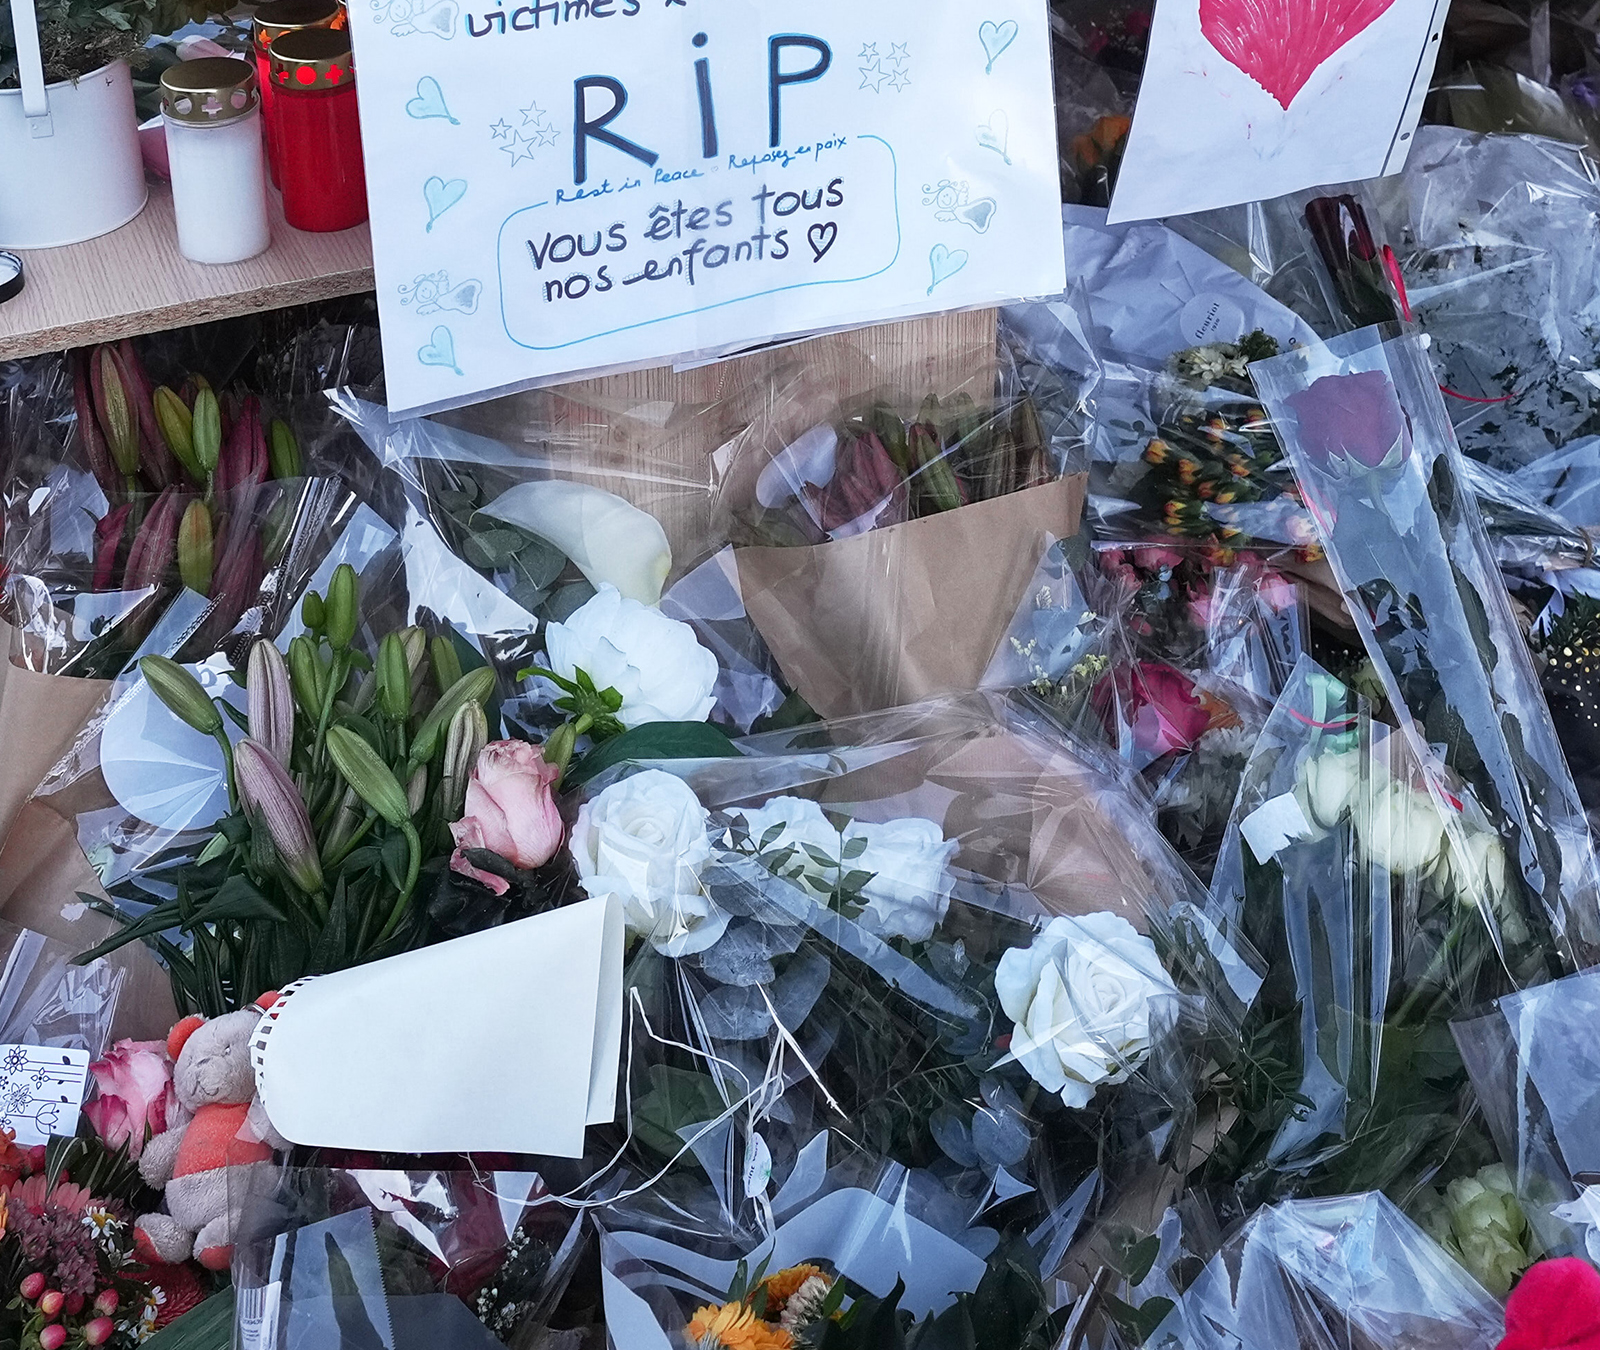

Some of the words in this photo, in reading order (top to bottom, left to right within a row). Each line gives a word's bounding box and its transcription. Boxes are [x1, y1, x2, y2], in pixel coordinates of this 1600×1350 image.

[556, 178, 614, 205] Rest
[618, 176, 641, 193] in
[654, 167, 705, 185] Peace
[814, 133, 848, 162] paix
[644, 197, 733, 240] êtes
[751, 177, 844, 227] tous
[542, 267, 612, 303] nos
[620, 228, 790, 286] enfants
